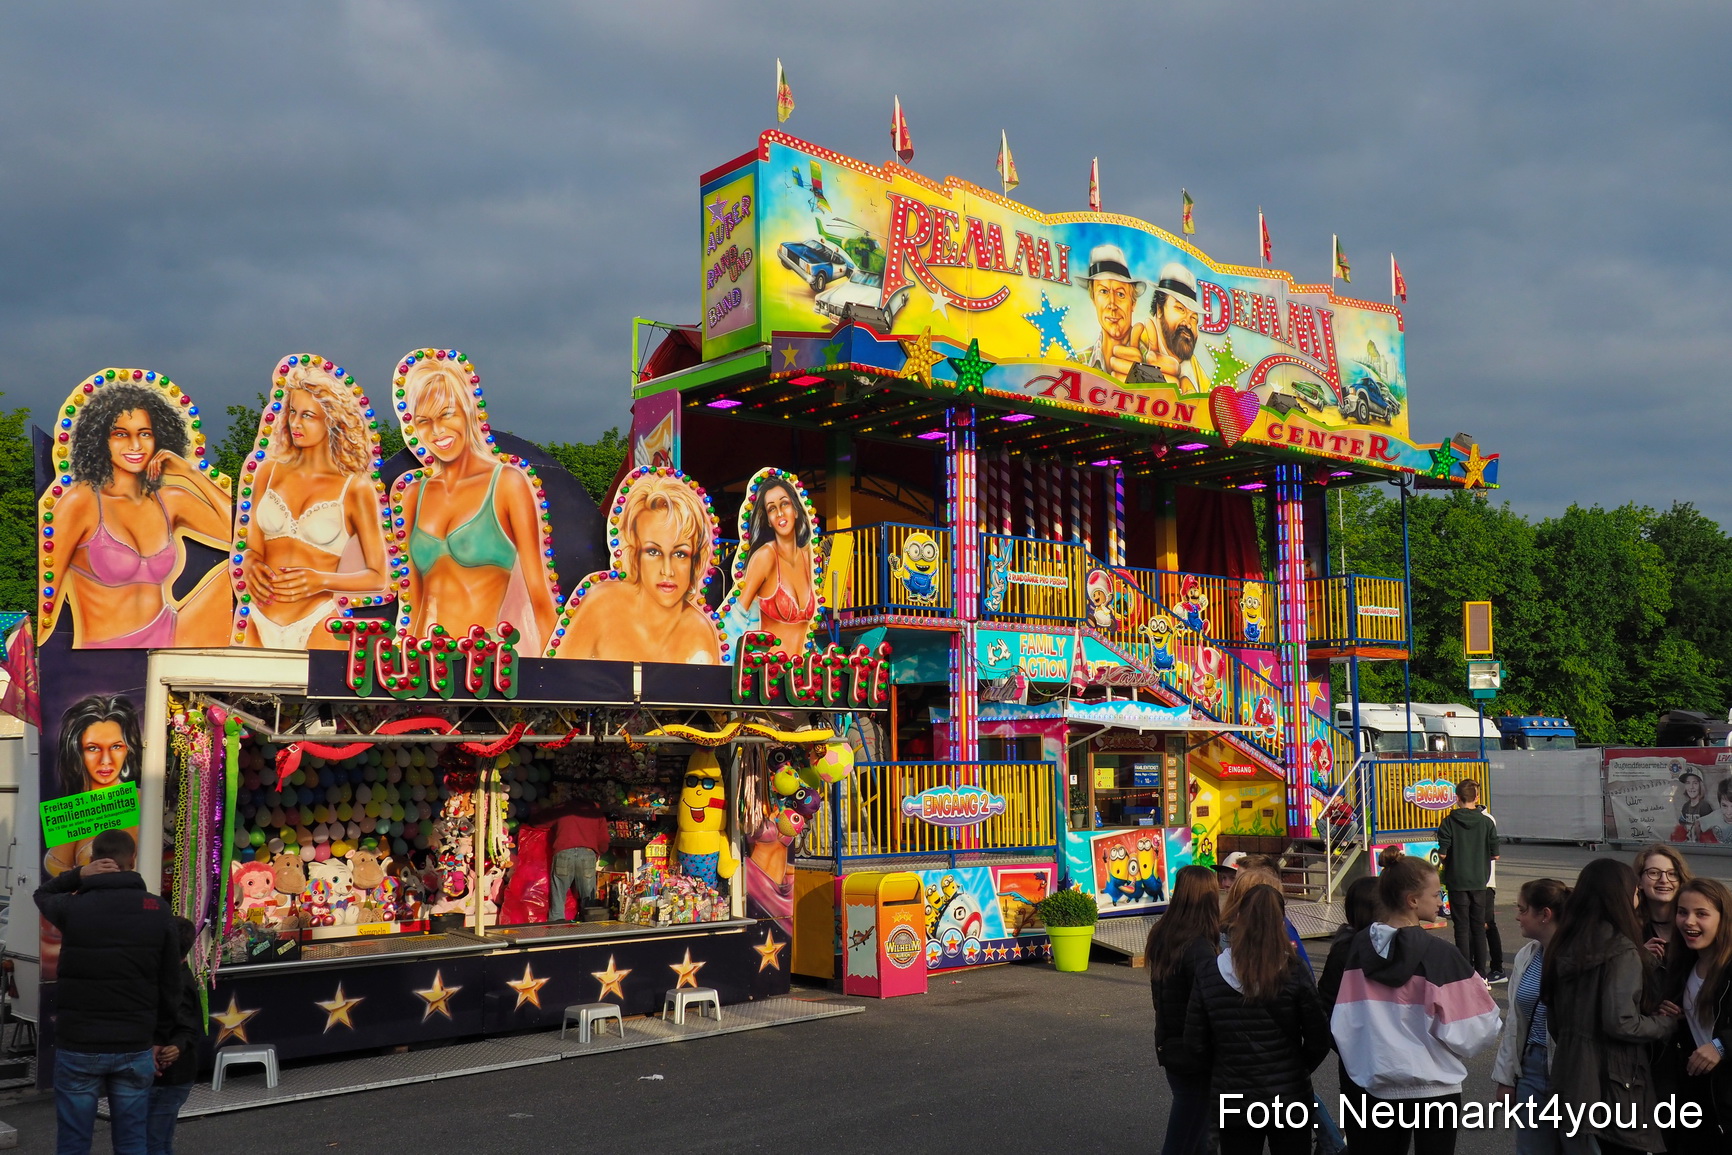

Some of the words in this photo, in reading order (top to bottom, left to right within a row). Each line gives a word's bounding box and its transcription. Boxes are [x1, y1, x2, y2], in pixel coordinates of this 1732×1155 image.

[707, 244, 738, 290] RAND
[729, 248, 752, 283] UND
[708, 287, 742, 329] BAND
[880, 190, 1072, 312] REMMI
[1197, 278, 1347, 407] DEMMI
[1024, 369, 1197, 423] ACTION
[1019, 634, 1066, 657] FAMILY
[325, 617, 518, 697] Tutti
[734, 630, 892, 706] Frutti
[1019, 656, 1067, 681] ACTION
[1096, 665, 1161, 687] Kasse
[1228, 765, 1252, 774] EINGANG
[1613, 761, 1668, 770] Jugendfeuerwehr
[43, 801, 74, 814] Freitag
[75, 798, 89, 807] 31.
[90, 791, 106, 803] Mai
[107, 786, 133, 800] großer
[923, 793, 979, 818] EINGANG
[980, 793, 990, 814] 2
[1415, 785, 1449, 803] EINGANG
[1625, 796, 1642, 807] Wir
[45, 797, 136, 827] Familiennachmittag
[67, 826, 92, 838] halbe
[93, 819, 122, 832] Preise
[885, 940, 921, 953] WILHELM
